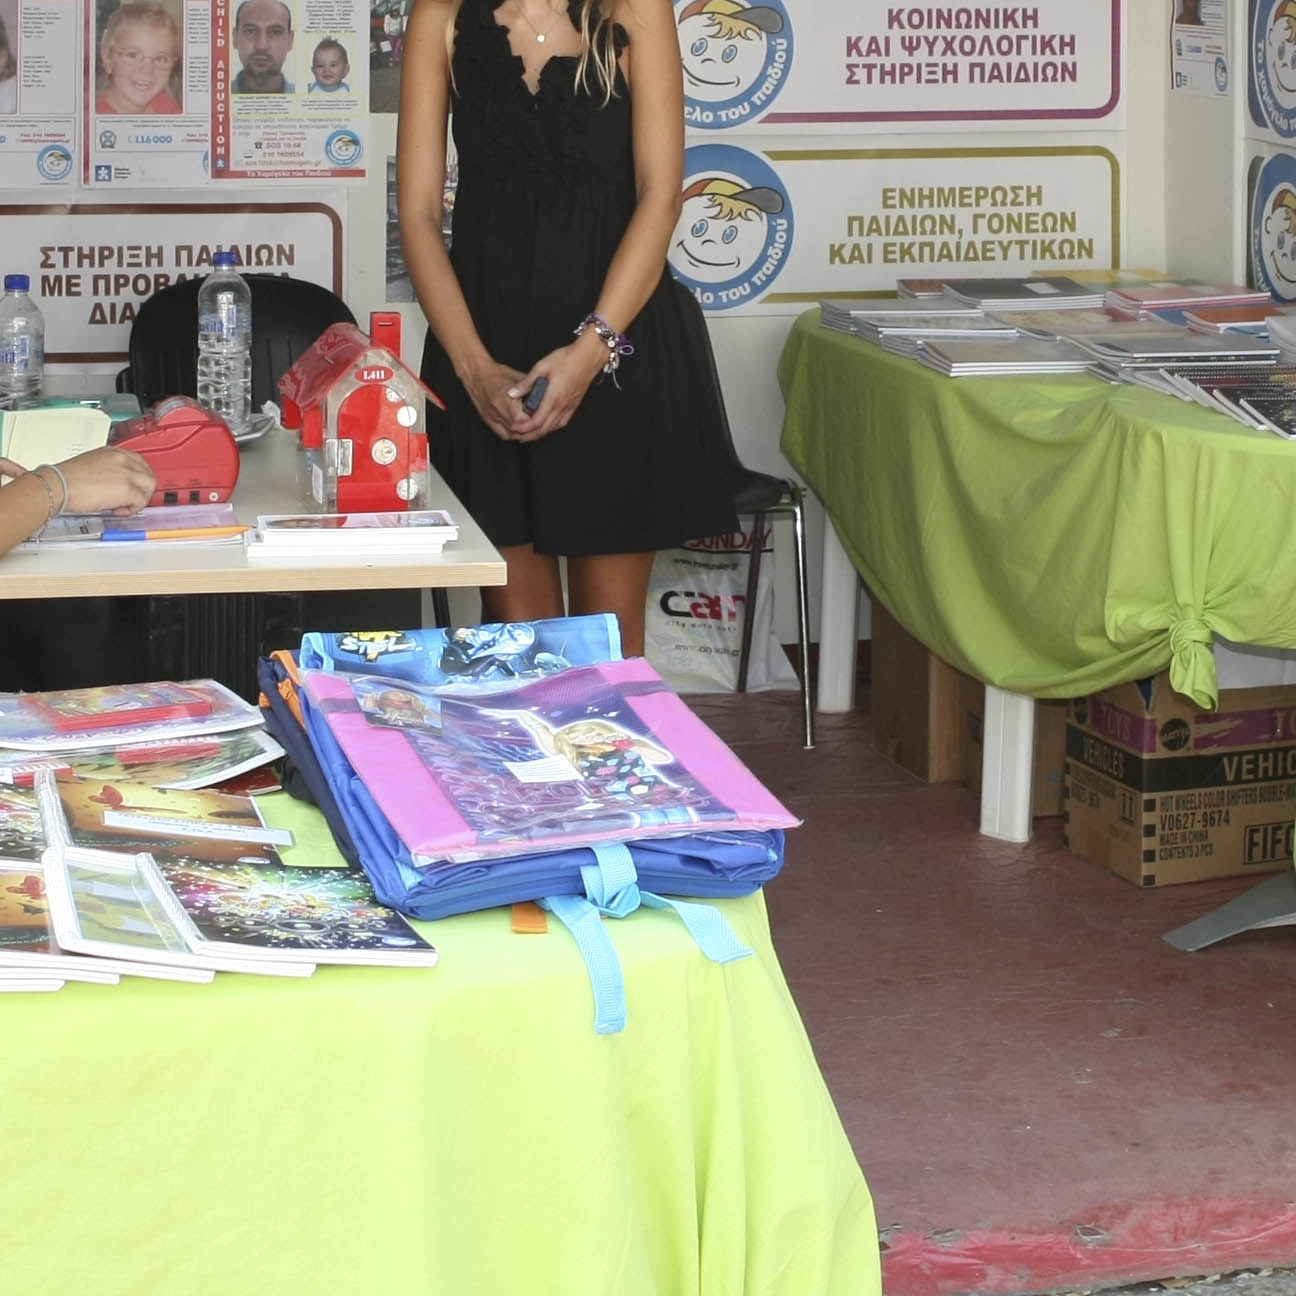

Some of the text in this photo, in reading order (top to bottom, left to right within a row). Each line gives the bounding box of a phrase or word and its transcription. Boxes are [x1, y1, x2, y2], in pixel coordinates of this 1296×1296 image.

[887, 7, 1039, 30] ΚΟΙΝΩΝΙΚΗ
[846, 35, 1076, 58] ΚΑΙ ΨΥΧΟΛΟΓΙΚΗ
[845, 61, 1078, 85] ΣΤΗΡΙΞΗ ΠΑΙΔΙΩΝ
[882, 185, 1043, 209] ΕΝΗΜΕΡΩΣΗ
[847, 211, 1077, 241] ΠΑΙΔΙΩΝ, ΓΟΝΕΩΝ
[39, 245, 163, 269] ΣΤΗΡΙΞΗ
[829, 238, 1094, 265] ΚΑΙ ΕΚΠΑΙΔΕΥΤΙΚΩΝ
[41, 275, 82, 297] ΜΕ
[1160, 830, 1208, 845] MADE IN CHINA
[1159, 843, 1214, 860] CONTENTS PCS
